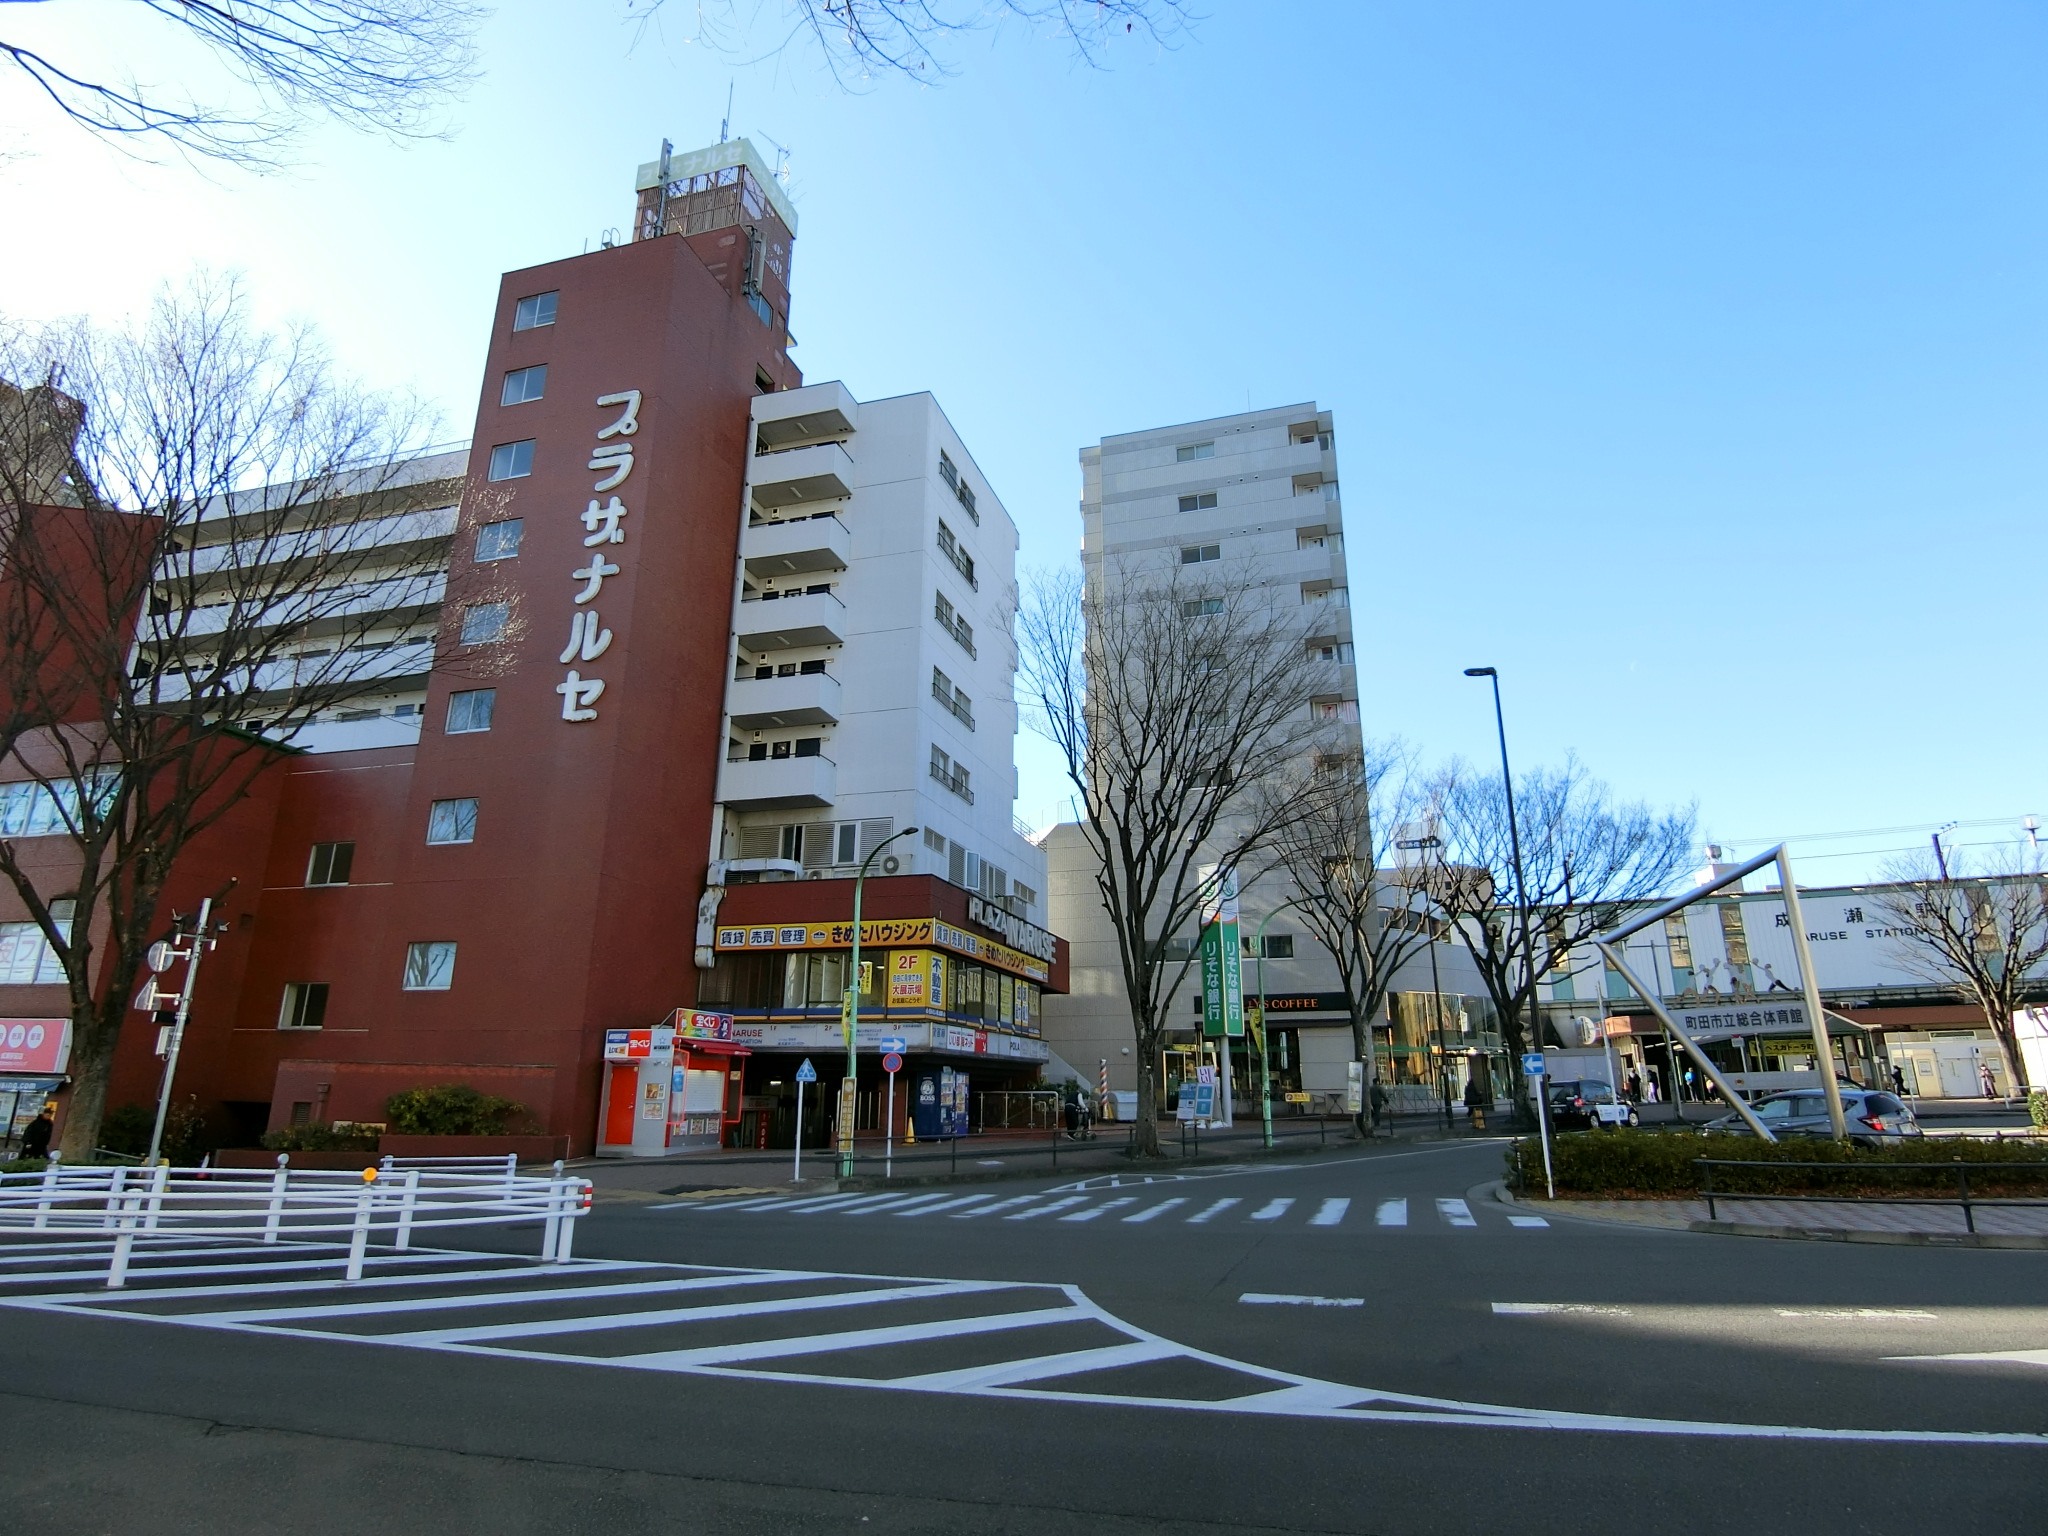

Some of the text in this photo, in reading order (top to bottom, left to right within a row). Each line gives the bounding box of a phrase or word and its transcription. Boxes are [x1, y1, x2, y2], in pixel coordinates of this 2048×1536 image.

[556, 389, 642, 722] プラザナルセ
[721, 921, 932, 944] 賃貸 売買 管理 きめたハウジング
[969, 896, 1007, 938] PLAZA
[1005, 915, 1057, 964] NARUSE
[899, 955, 918, 969] 2F
[892, 984, 922, 995] 大展示場
[932, 957, 942, 1004] 不動産
[1206, 941, 1221, 1020] りそな銀行
[1226, 941, 1239, 1020] りそな銀行
[1271, 998, 1319, 1009] COFFEE
[696, 1015, 716, 1028] 宝くじ
[1685, 1008, 1804, 1030] 町田市立総合体育館
[629, 1040, 651, 1049] 宝くじ
